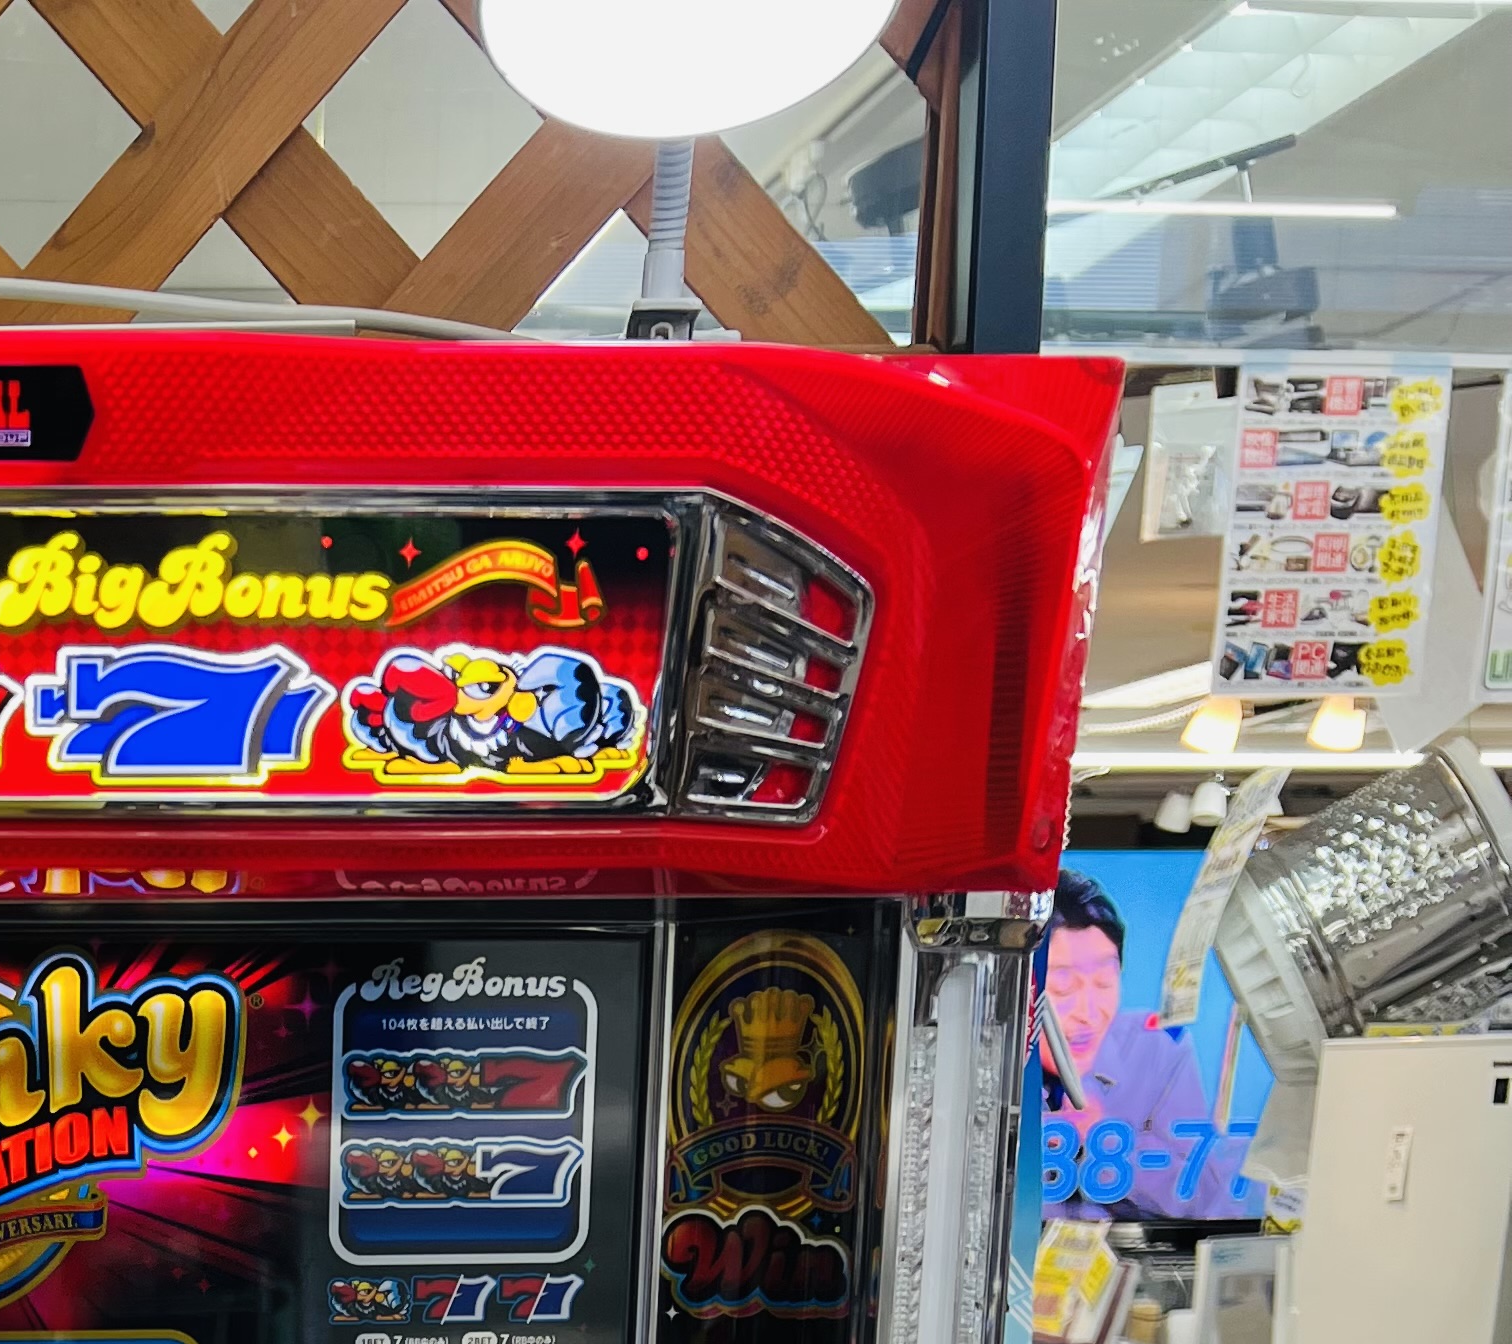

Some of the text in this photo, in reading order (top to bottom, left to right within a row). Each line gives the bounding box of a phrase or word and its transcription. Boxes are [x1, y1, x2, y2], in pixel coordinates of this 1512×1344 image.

[1297, 644, 1326, 658] PC
[692, 1130, 830, 1167] GOOD LUCK!
